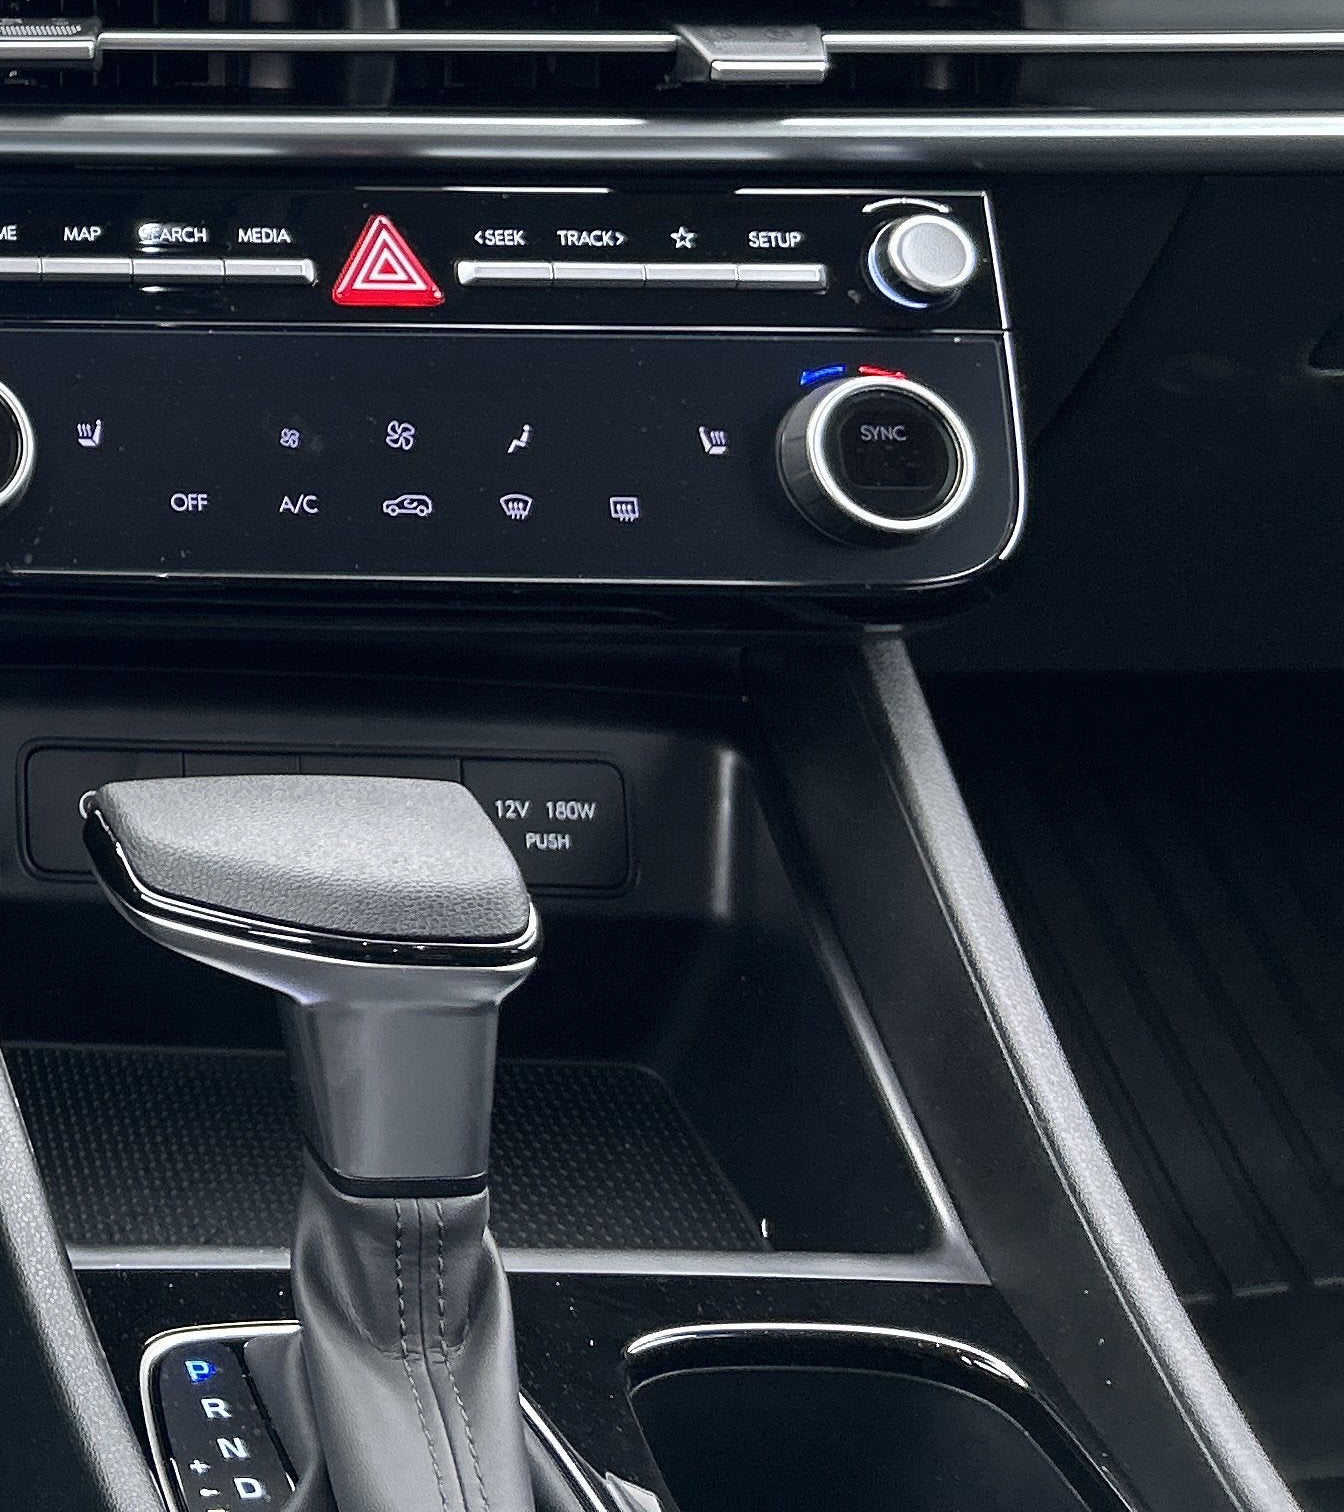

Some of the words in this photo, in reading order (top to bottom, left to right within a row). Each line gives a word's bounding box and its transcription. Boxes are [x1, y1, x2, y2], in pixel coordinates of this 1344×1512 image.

[63, 225, 101, 242] MAP
[238, 226, 290, 244] MEDIA
[748, 231, 802, 249] SETUP
[860, 425, 906, 442] SYNC
[170, 494, 209, 512] OFF
[279, 494, 319, 514] A/C
[495, 800, 530, 819] 12V
[546, 801, 596, 821] 180W
[526, 833, 571, 849] PUSH
[184, 1360, 215, 1384] P
[201, 1398, 233, 1419] R
[216, 1437, 250, 1461] N
[234, 1477, 263, 1501] D
